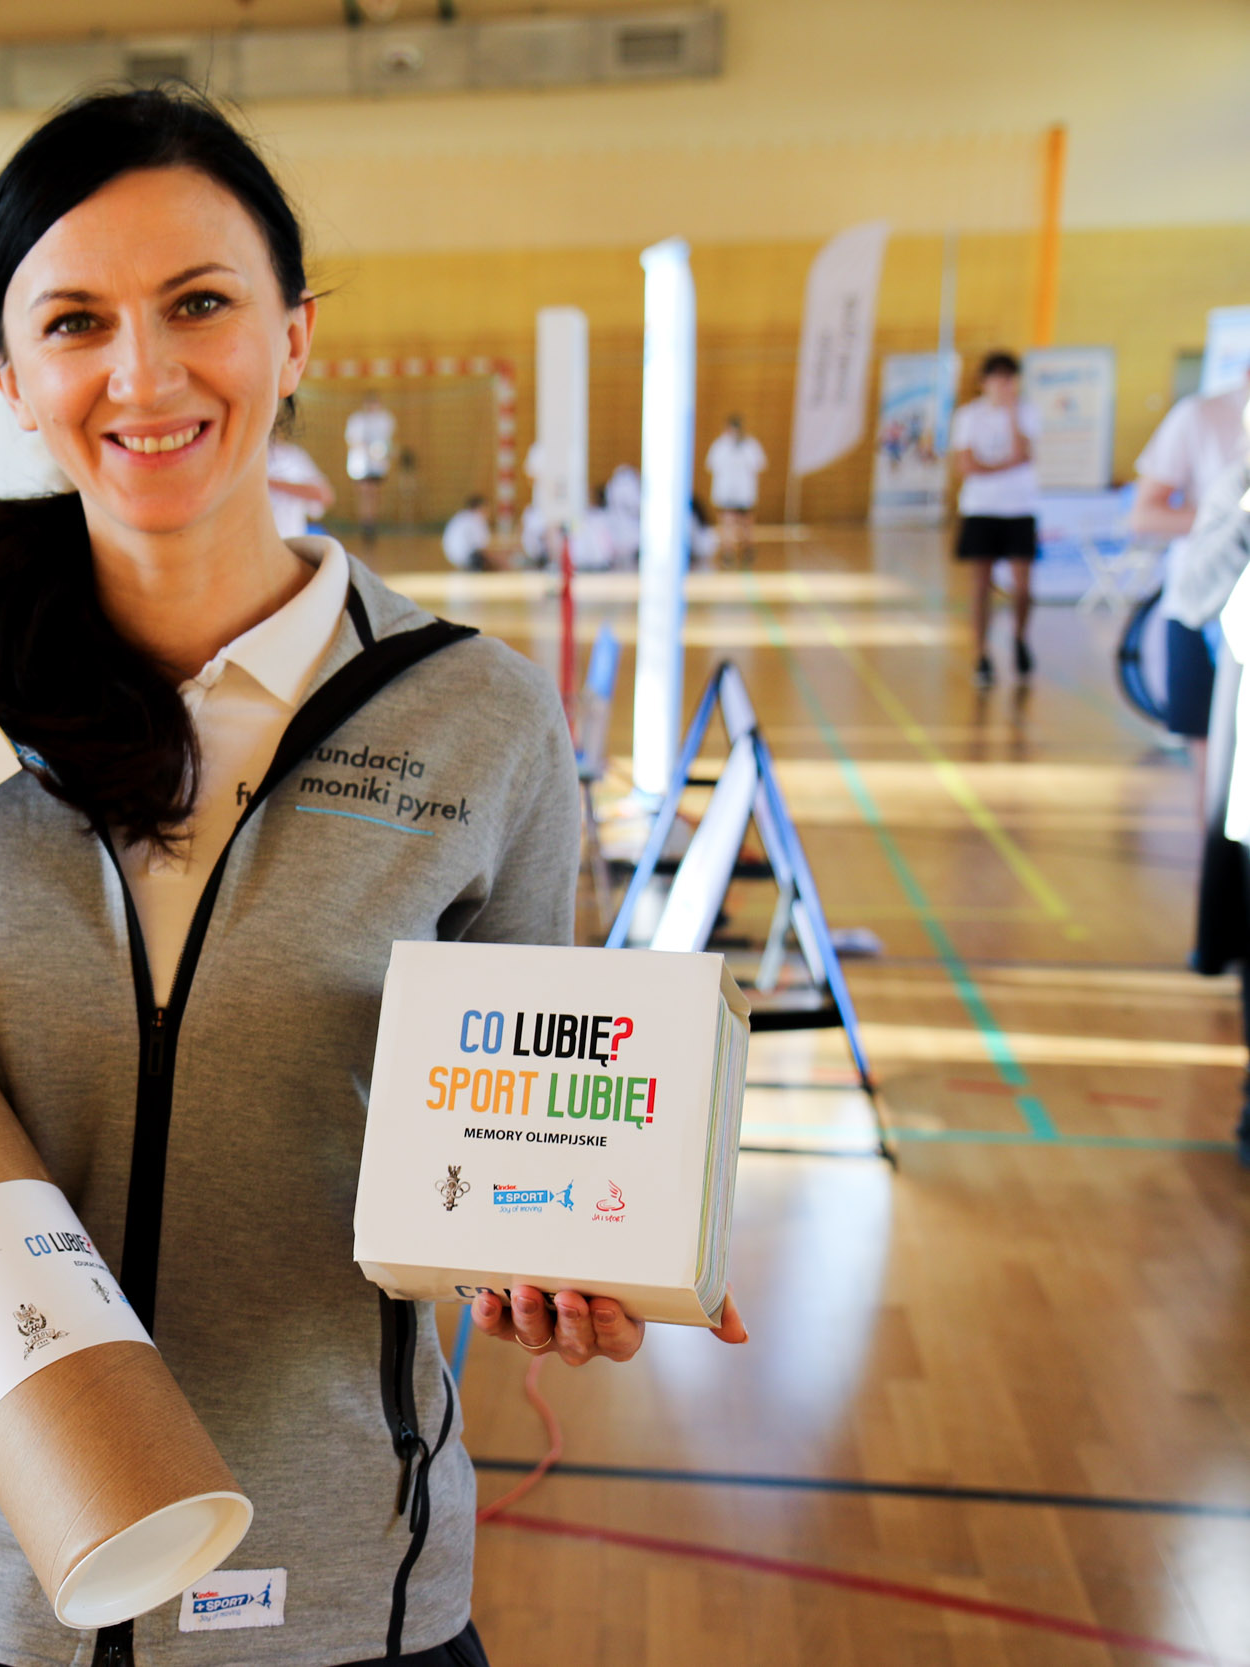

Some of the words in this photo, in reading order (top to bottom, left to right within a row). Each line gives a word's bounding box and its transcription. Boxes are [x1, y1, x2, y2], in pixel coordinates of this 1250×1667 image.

[300, 776, 392, 805] moniki
[395, 798, 472, 826] pyrek
[459, 1009, 504, 1054] CO
[512, 1012, 634, 1067] LUBIĘ?
[426, 1066, 539, 1116] SPORT
[547, 1072, 657, 1130] LUBIĘ!
[463, 1127, 523, 1142] MEMORY
[525, 1131, 608, 1147] OLIMPIJSKIE
[24, 1234, 52, 1257] CO
